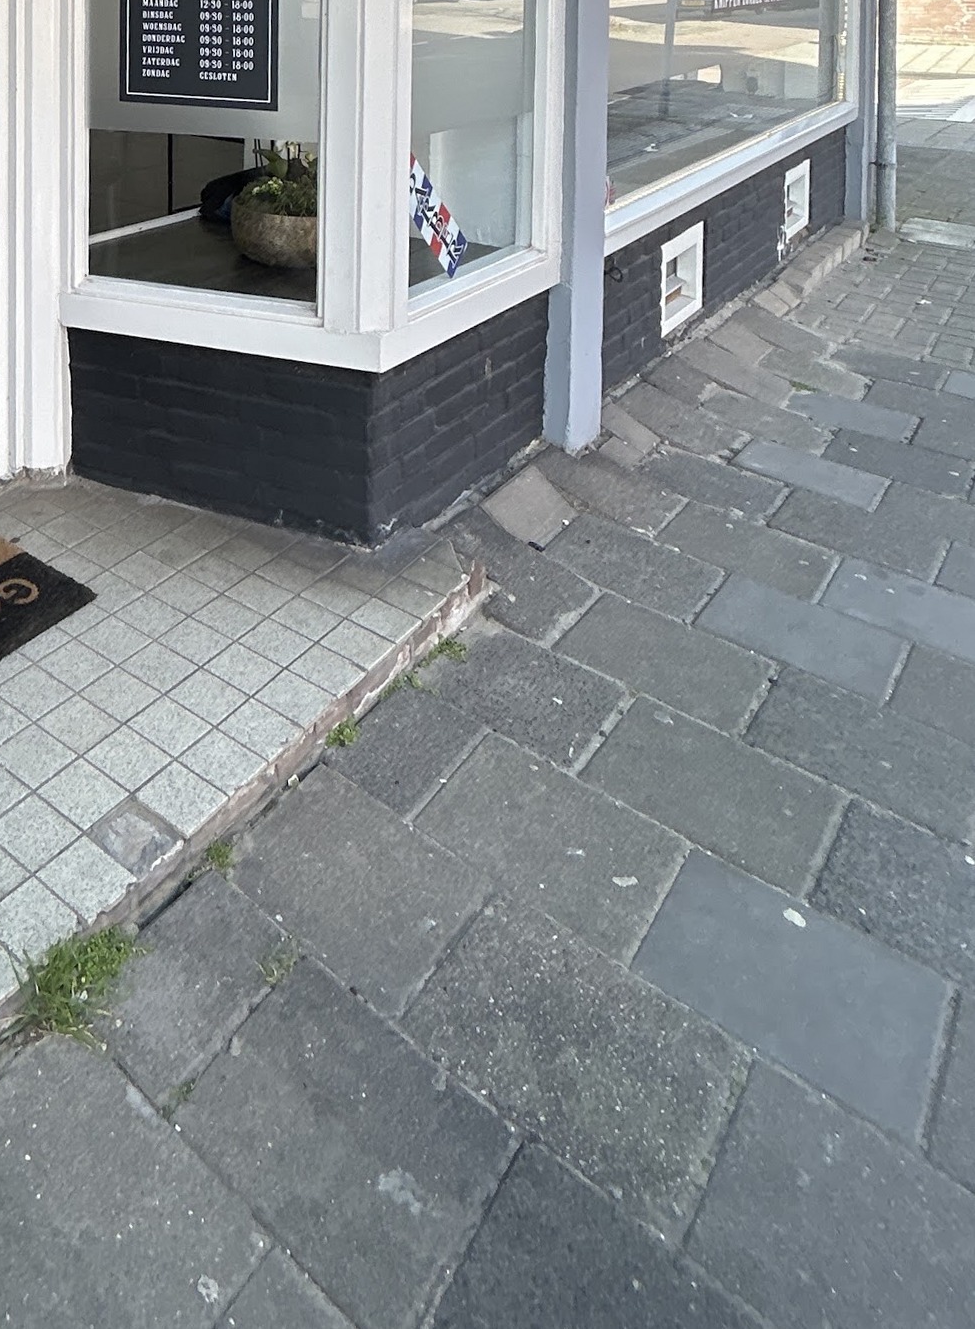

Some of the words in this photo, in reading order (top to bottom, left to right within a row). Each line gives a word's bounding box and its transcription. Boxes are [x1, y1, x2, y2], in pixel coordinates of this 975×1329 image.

[142, 10, 174, 19] DINSDAG
[142, 22, 182, 32] WOENSDAG
[142, 34, 186, 43] DONDERDAG
[142, 46, 174, 55] VRIJDAG
[142, 57, 180, 67] ZATERDAG
[199, 71, 237, 82] GESLOTEN
